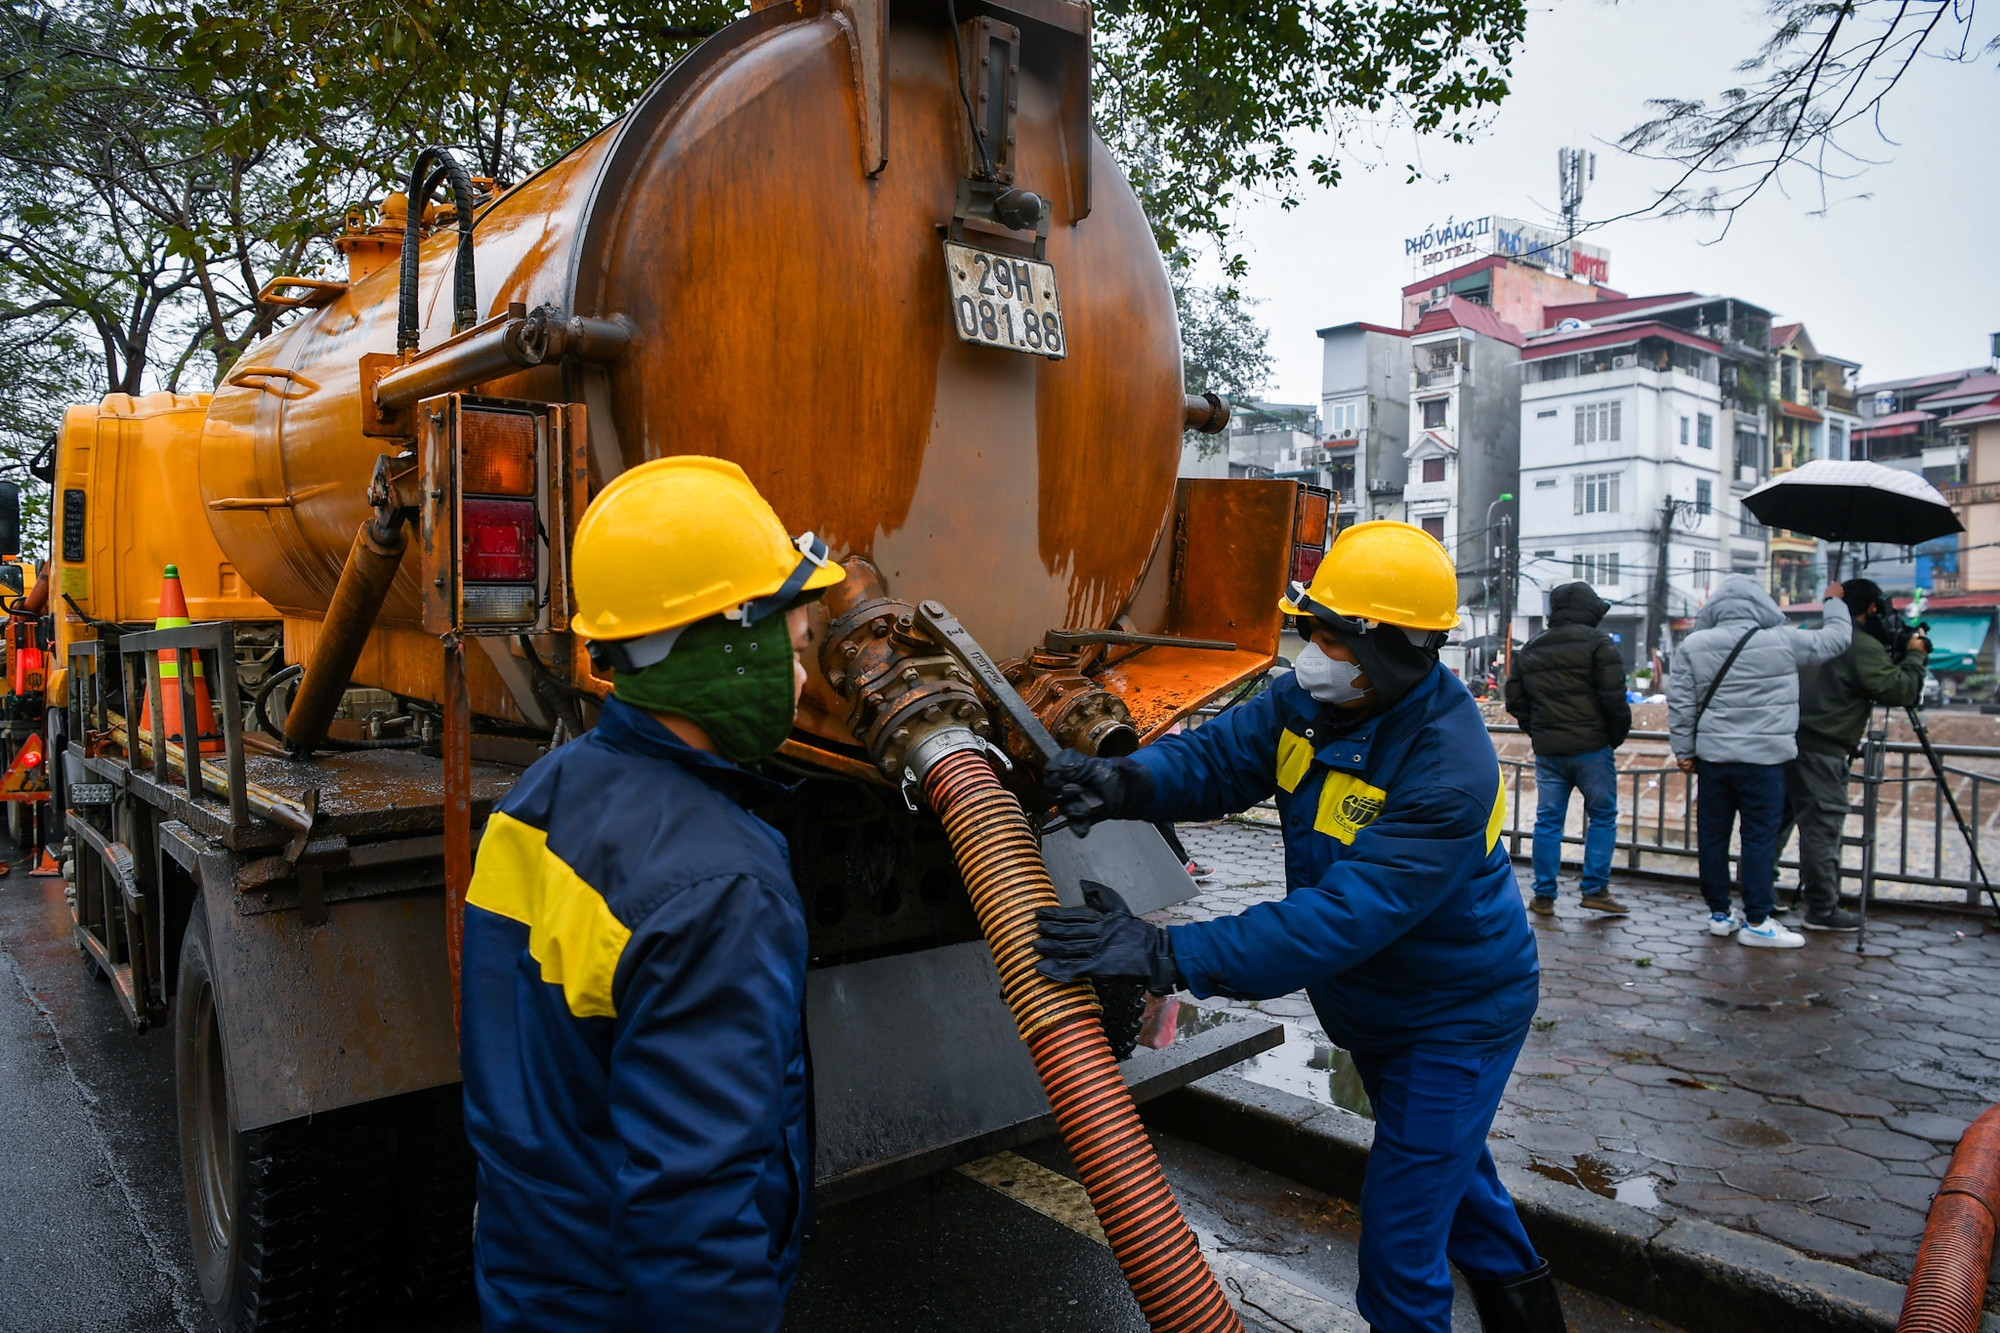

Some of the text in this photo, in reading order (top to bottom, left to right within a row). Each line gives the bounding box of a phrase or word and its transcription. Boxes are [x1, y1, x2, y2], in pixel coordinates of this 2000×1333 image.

[1476, 216, 1491, 236] II
[1422, 242, 1476, 266] HOTEL
[974, 253, 1034, 304] 29H
